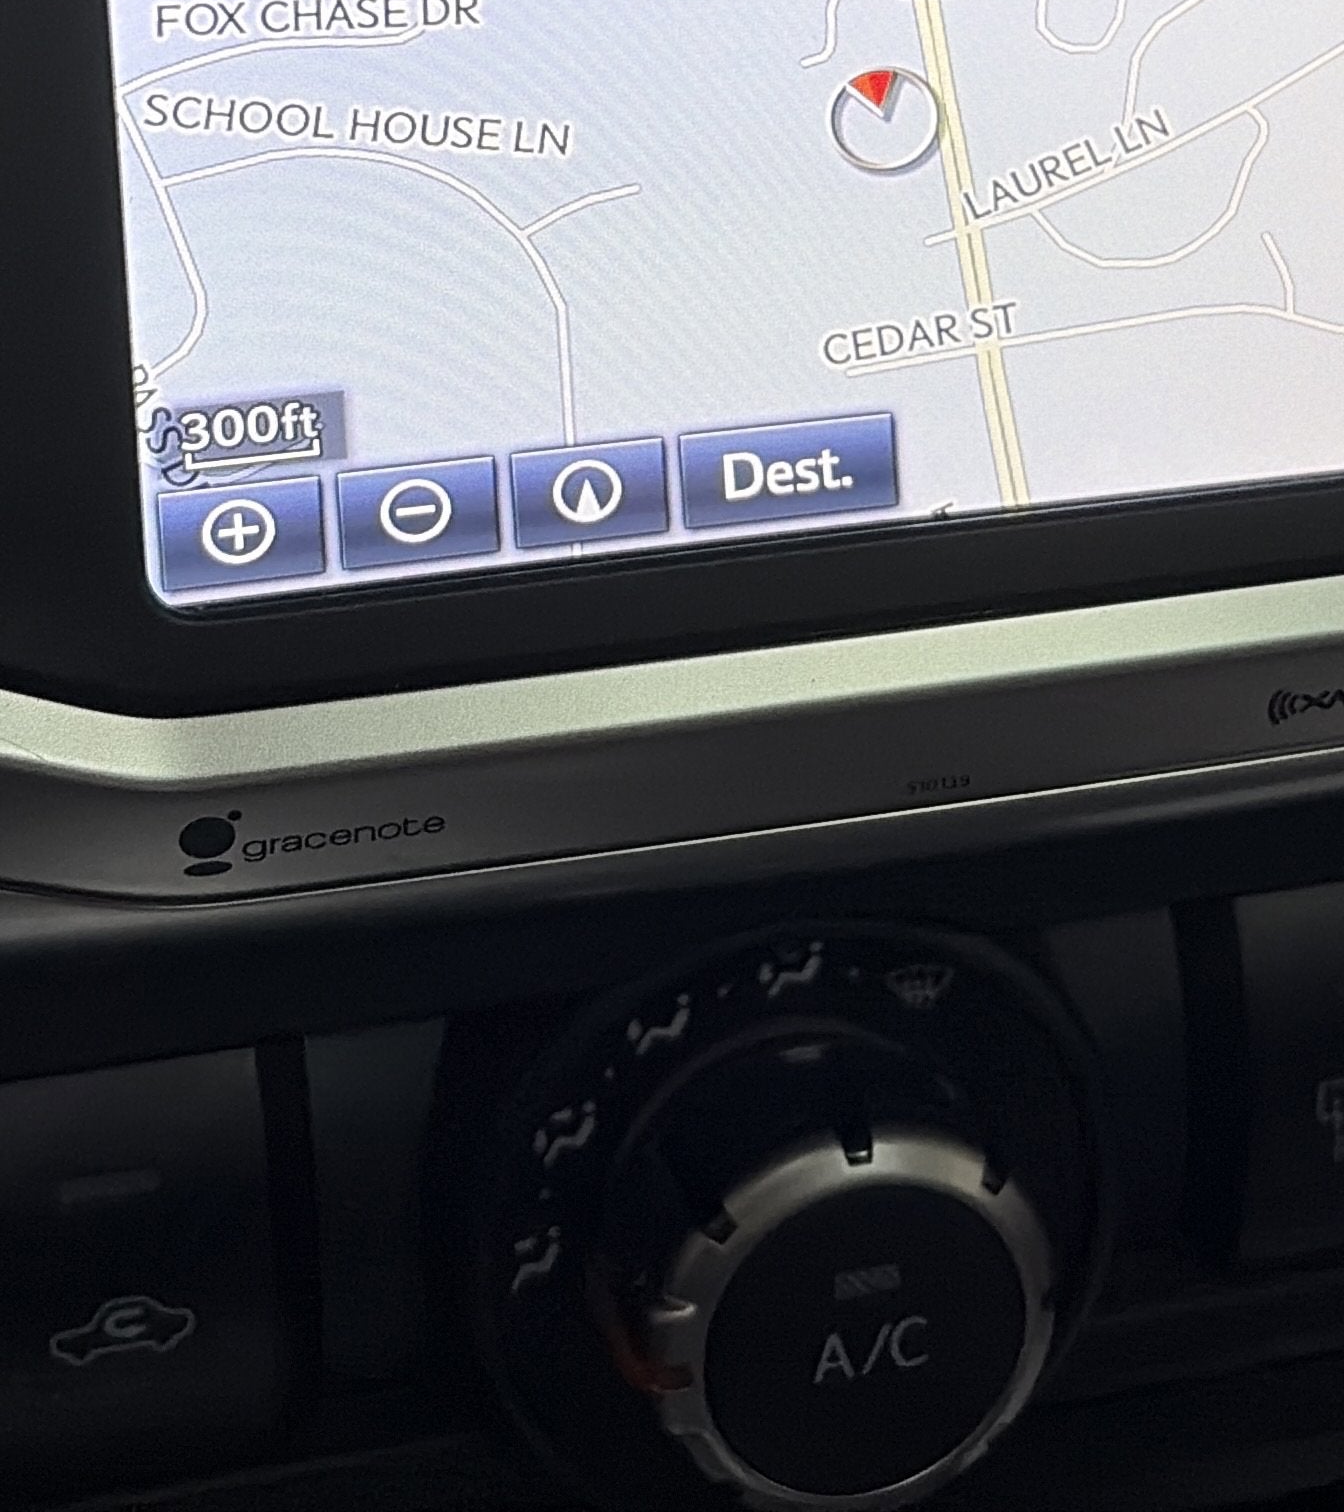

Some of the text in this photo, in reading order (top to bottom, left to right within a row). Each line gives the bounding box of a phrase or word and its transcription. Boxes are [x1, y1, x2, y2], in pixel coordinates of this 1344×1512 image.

[156, 1, 247, 37] FOX
[144, 93, 570, 156] SCHOOL HOUSE LN
[962, 108, 1171, 220] LAUREL LN
[823, 302, 1018, 368] CEDAR ST
[178, 401, 320, 452] 300ft
[722, 448, 855, 502] Dest.
[241, 816, 446, 862] gracenote
[813, 1316, 929, 1384] A/C
